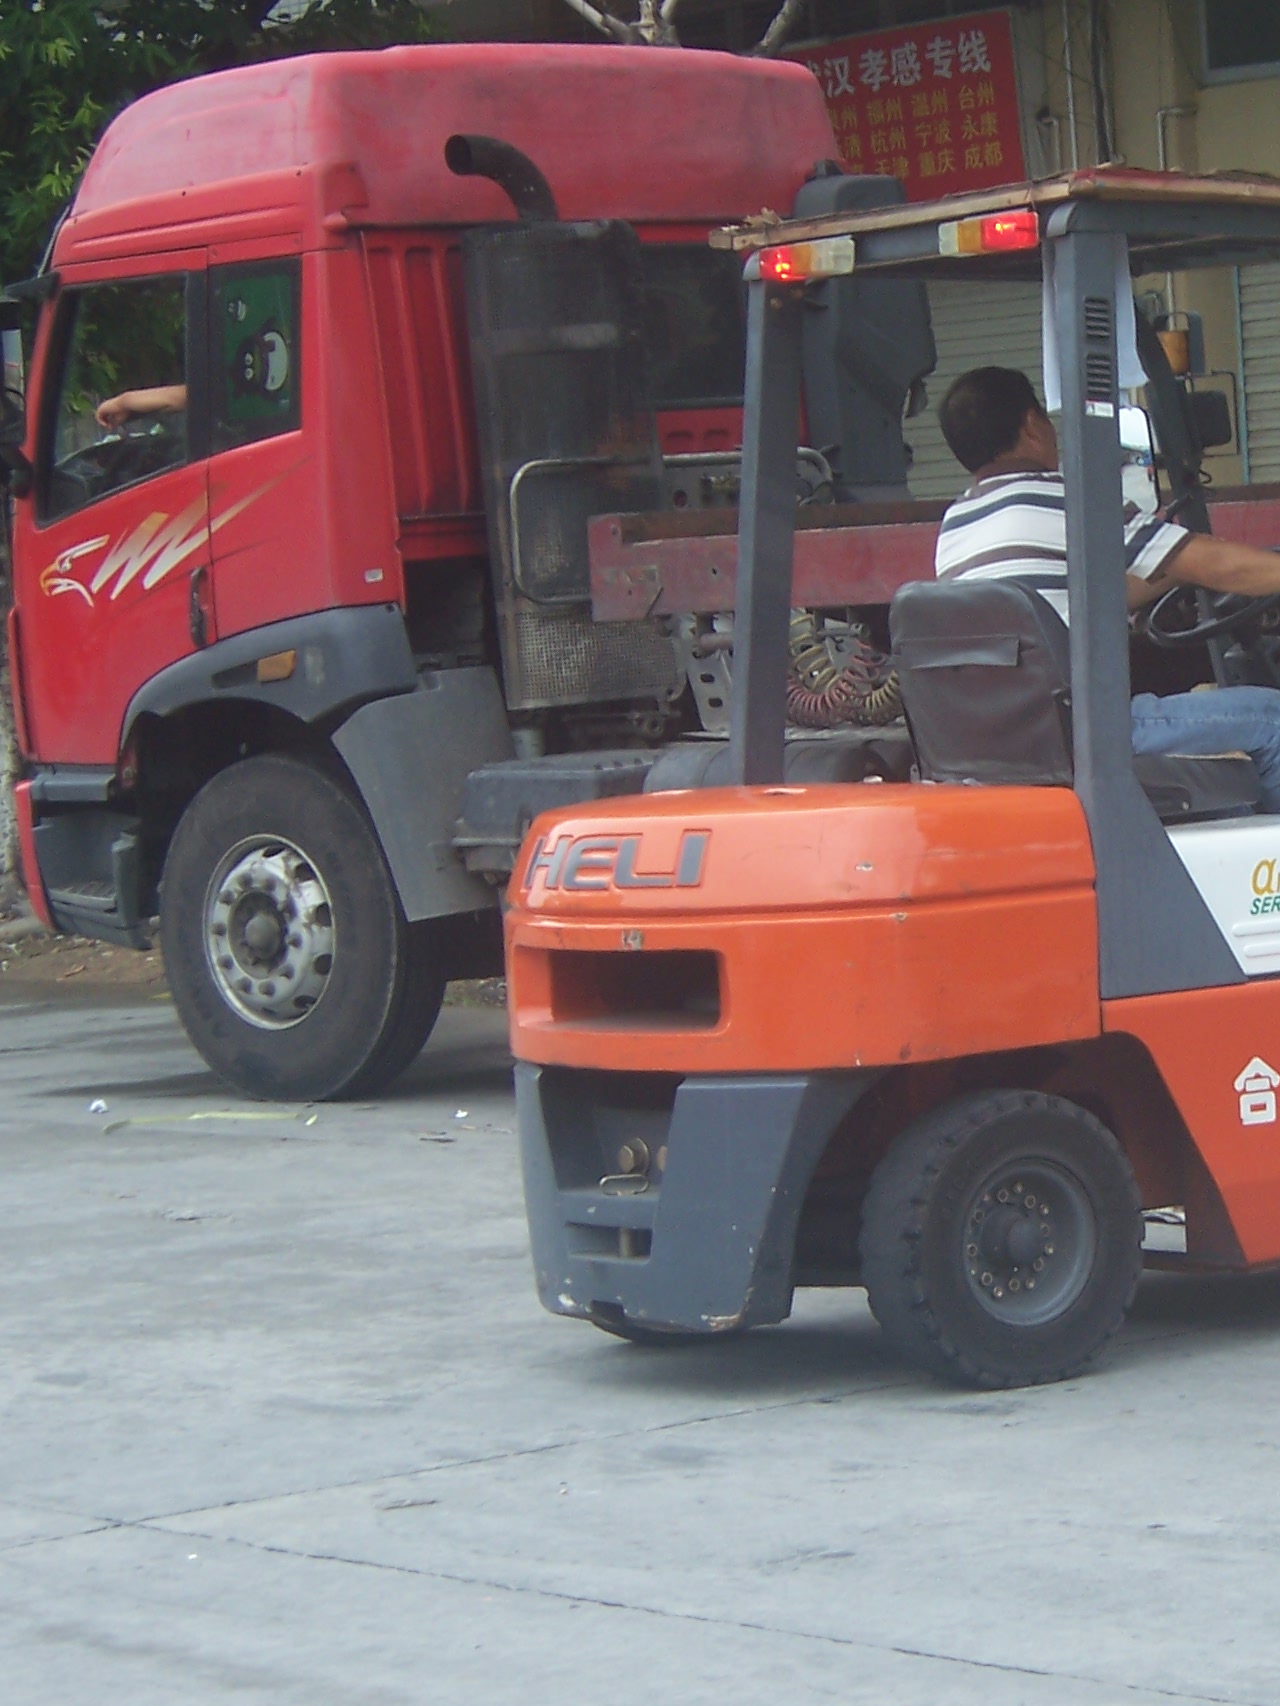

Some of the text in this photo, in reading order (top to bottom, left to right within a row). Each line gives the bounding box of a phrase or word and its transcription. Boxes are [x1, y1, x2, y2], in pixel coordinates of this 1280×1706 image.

[958, 80, 995, 110] 台州
[870, 126, 907, 154] 杭州
[915, 118, 952, 148] 宁波
[962, 110, 998, 141] 永康
[919, 148, 956, 178] 重庆
[965, 141, 1003, 170] 成都
[524, 829, 711, 890] HELI
